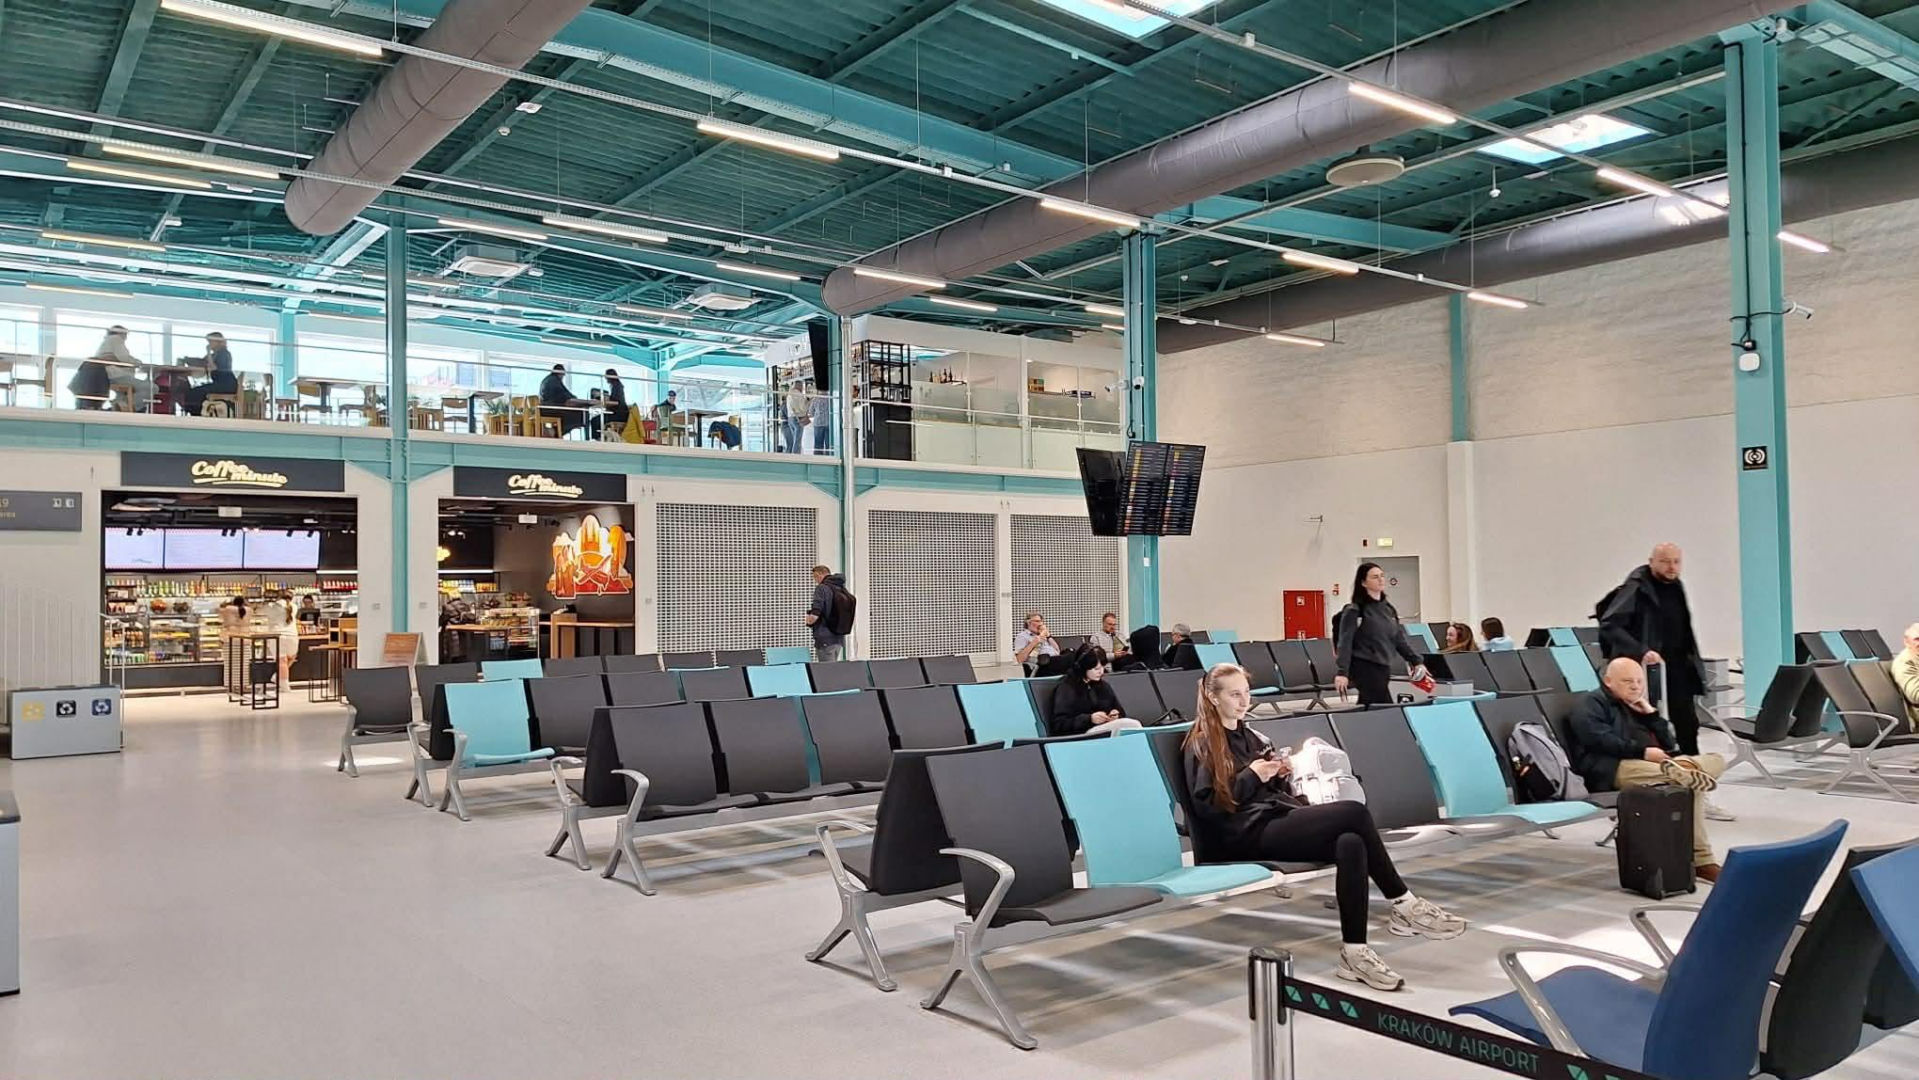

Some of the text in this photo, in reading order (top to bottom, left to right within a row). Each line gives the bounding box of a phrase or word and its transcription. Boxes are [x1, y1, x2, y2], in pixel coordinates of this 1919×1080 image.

[191, 460, 249, 477] Coffee
[1378, 1012, 1539, 1073] KRAKÓW AIRPORT
